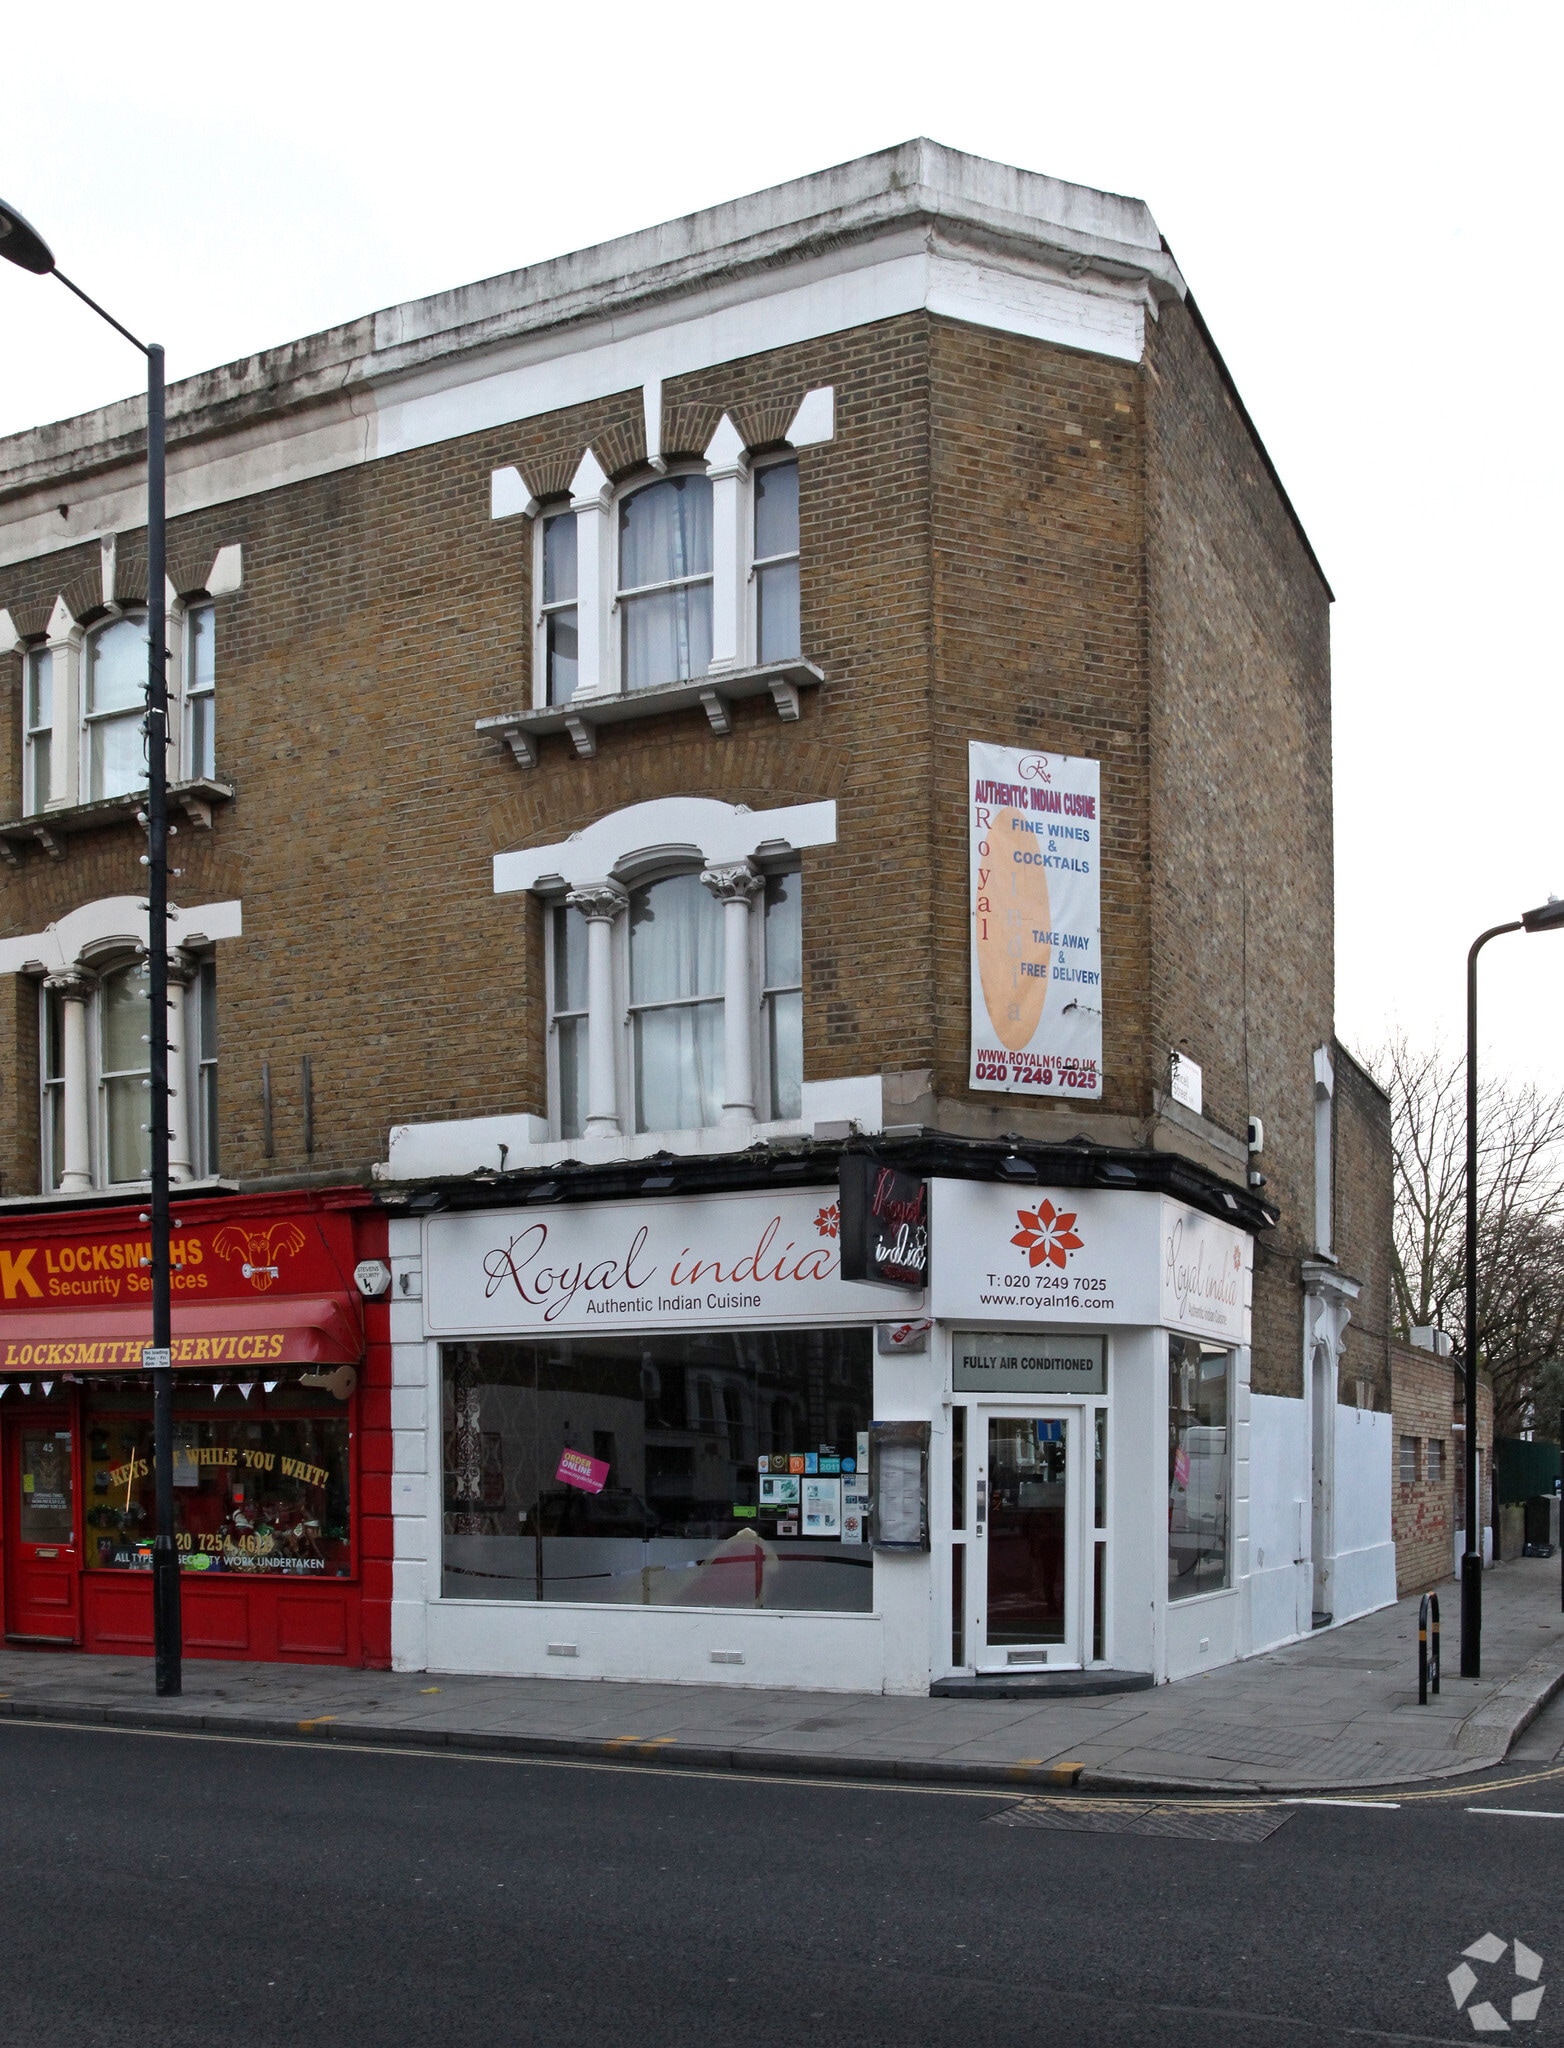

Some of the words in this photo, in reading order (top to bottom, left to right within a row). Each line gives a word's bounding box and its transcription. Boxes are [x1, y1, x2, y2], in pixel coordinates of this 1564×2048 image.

[975, 779, 1028, 809] AUTHENTIC
[1031, 787, 1061, 814] INDIAN
[1064, 793, 1096, 820] CUSINE
[1012, 818, 1043, 835] FINE
[1048, 823, 1090, 842] WINES
[1048, 840, 1057, 852] &
[975, 806, 992, 940] Royal
[1013, 851, 1090, 874] COCKTAILS
[1032, 930, 1060, 946] TAKE
[1062, 934, 1090, 950] AWAY
[1058, 950, 1065, 963] &
[1020, 962, 1047, 978] FREE
[1053, 966, 1100, 985] DELIVERY
[977, 1049, 1097, 1072] WWW.ROYALN16.CO.UK
[976, 1063, 1007, 1081] 020
[1013, 1065, 1053, 1085] 7249
[1058, 1070, 1097, 1089] 7025
[45, 1239, 203, 1273] LOCKSMIHS
[483, 1223, 657, 1321] Royal
[670, 1216, 841, 1286] india
[1166, 1218, 1204, 1319] Royal
[49, 1276, 121, 1297] Security
[127, 1273, 208, 1292] Seices
[987, 1274, 1000, 1286] T:
[1004, 1275, 1030, 1287] 020
[1035, 1276, 1068, 1289] 7249
[1074, 1278, 1107, 1290] 7025
[586, 1297, 653, 1313] Authentic
[658, 1295, 702, 1311] Indian
[707, 1293, 761, 1308] Cuisine
[980, 1295, 1114, 1309] www.royaln16.com
[963, 1356, 997, 1368] FULLY
[1000, 1357, 1018, 1369] AIR
[1021, 1357, 1093, 1370] CONDITIONED
[43, 1443, 54, 1452] 45
[185, 1448, 238, 1466] WHILE
[245, 1450, 275, 1471] YOU
[281, 1457, 329, 1488] WAIT!
[562, 1460, 592, 1476] ONLINE
[564, 1452, 591, 1468] ORDER
[175, 1533, 192, 1550] 20
[198, 1534, 231, 1551] 7254
[115, 1553, 130, 1562] ALL
[132, 1554, 153, 1563] TYPE
[224, 1557, 254, 1567] WORK
[257, 1558, 325, 1569] UNDERTAKEN
